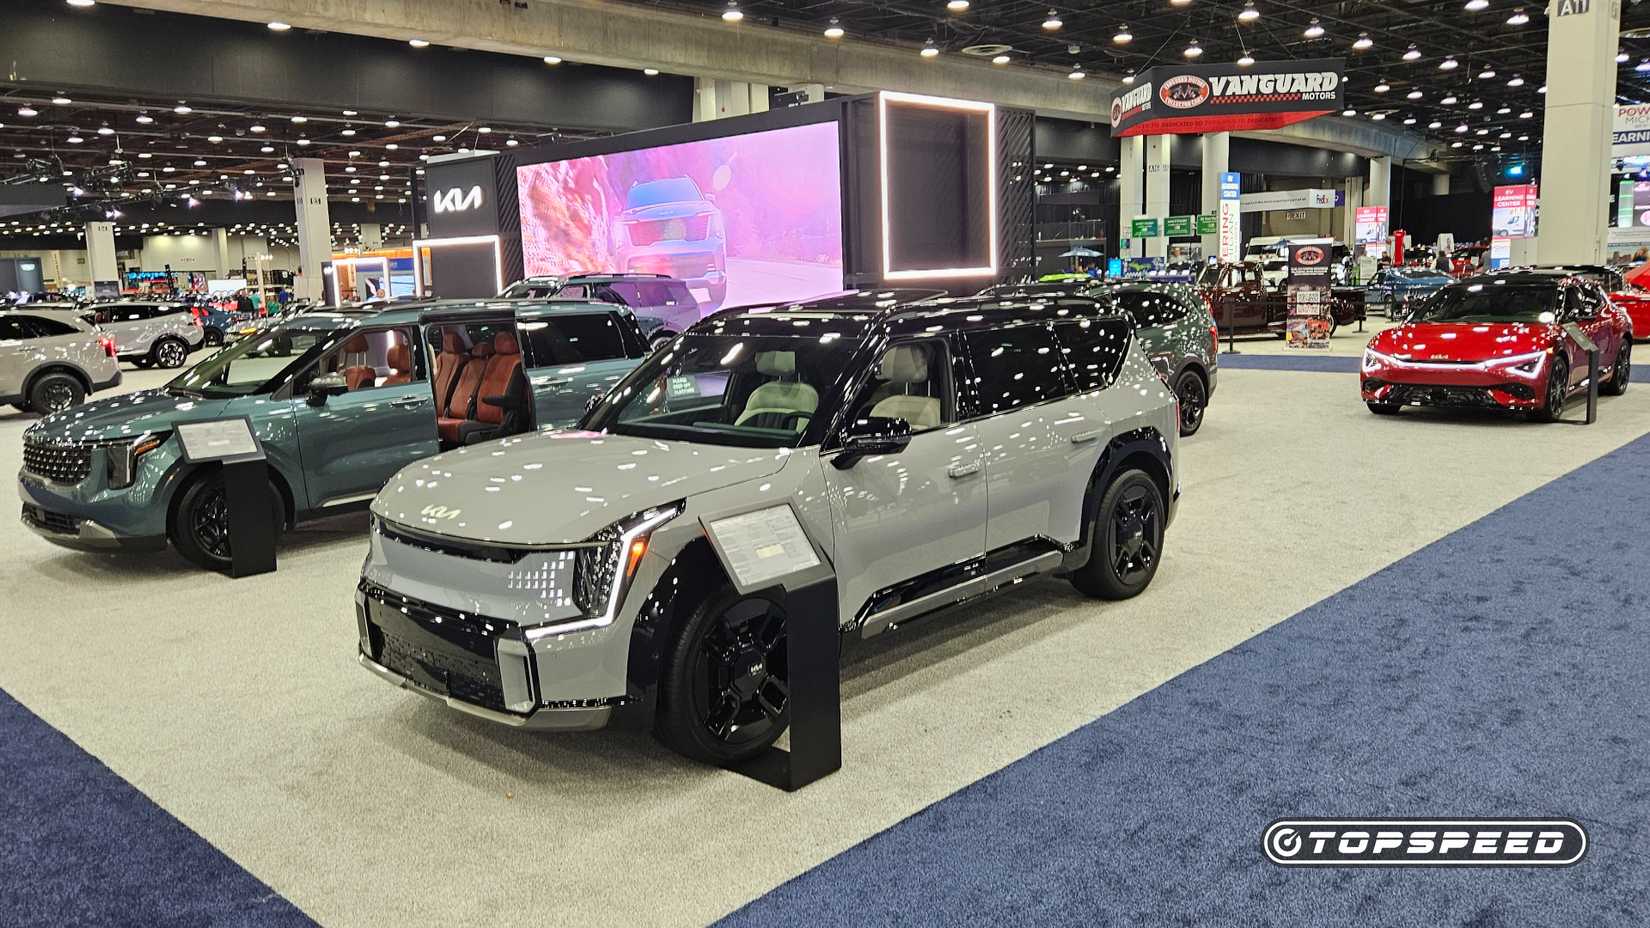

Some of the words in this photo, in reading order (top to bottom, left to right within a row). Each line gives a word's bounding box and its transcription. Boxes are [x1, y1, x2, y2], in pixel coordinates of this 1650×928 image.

[1208, 72, 1338, 96] VANGUARD
[1302, 91, 1336, 101] MOTORS
[434, 185, 482, 213] KIA
[421, 504, 461, 520] KIA
